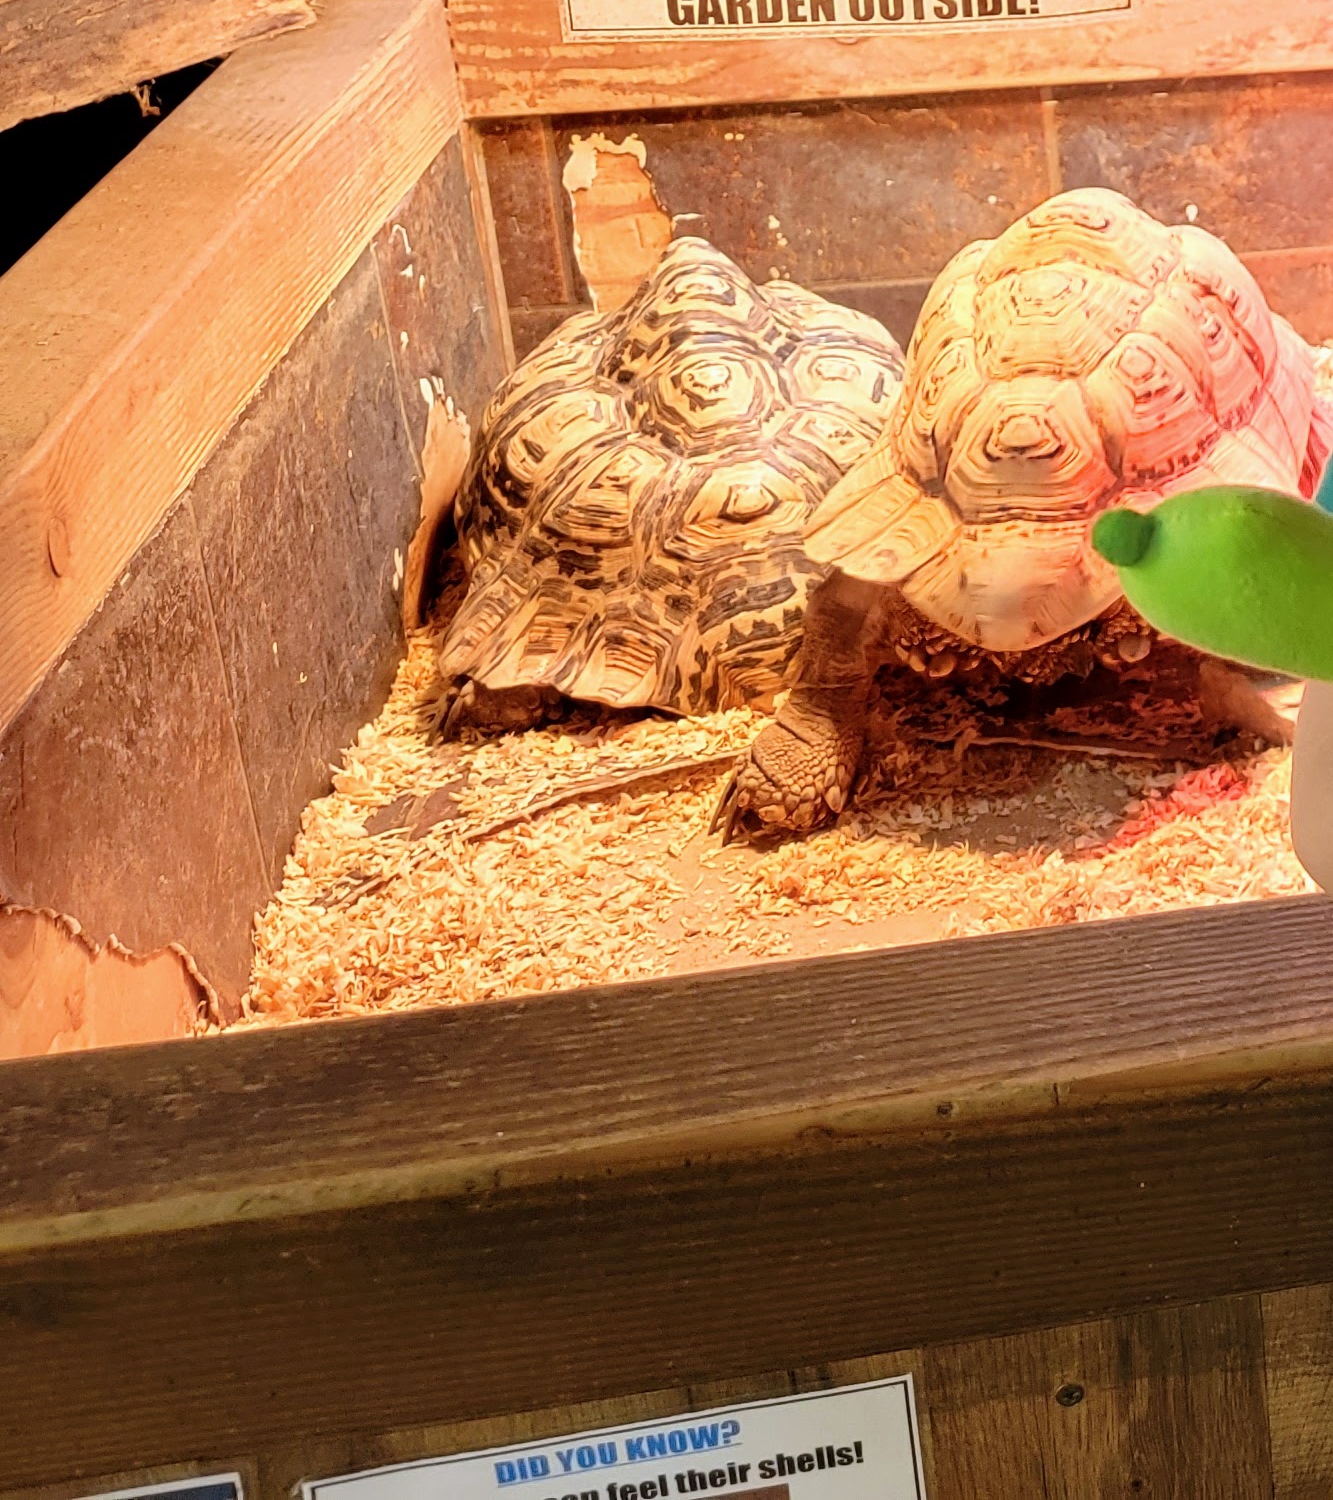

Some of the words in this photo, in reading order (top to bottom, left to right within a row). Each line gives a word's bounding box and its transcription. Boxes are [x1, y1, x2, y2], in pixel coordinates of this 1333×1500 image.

[494, 1454, 551, 1485] DID
[555, 1441, 619, 1473] YOU
[624, 1419, 741, 1462] KNOW?
[606, 1474, 670, 1500] feel
[674, 1461, 752, 1494] their
[758, 1440, 865, 1480] shells!
